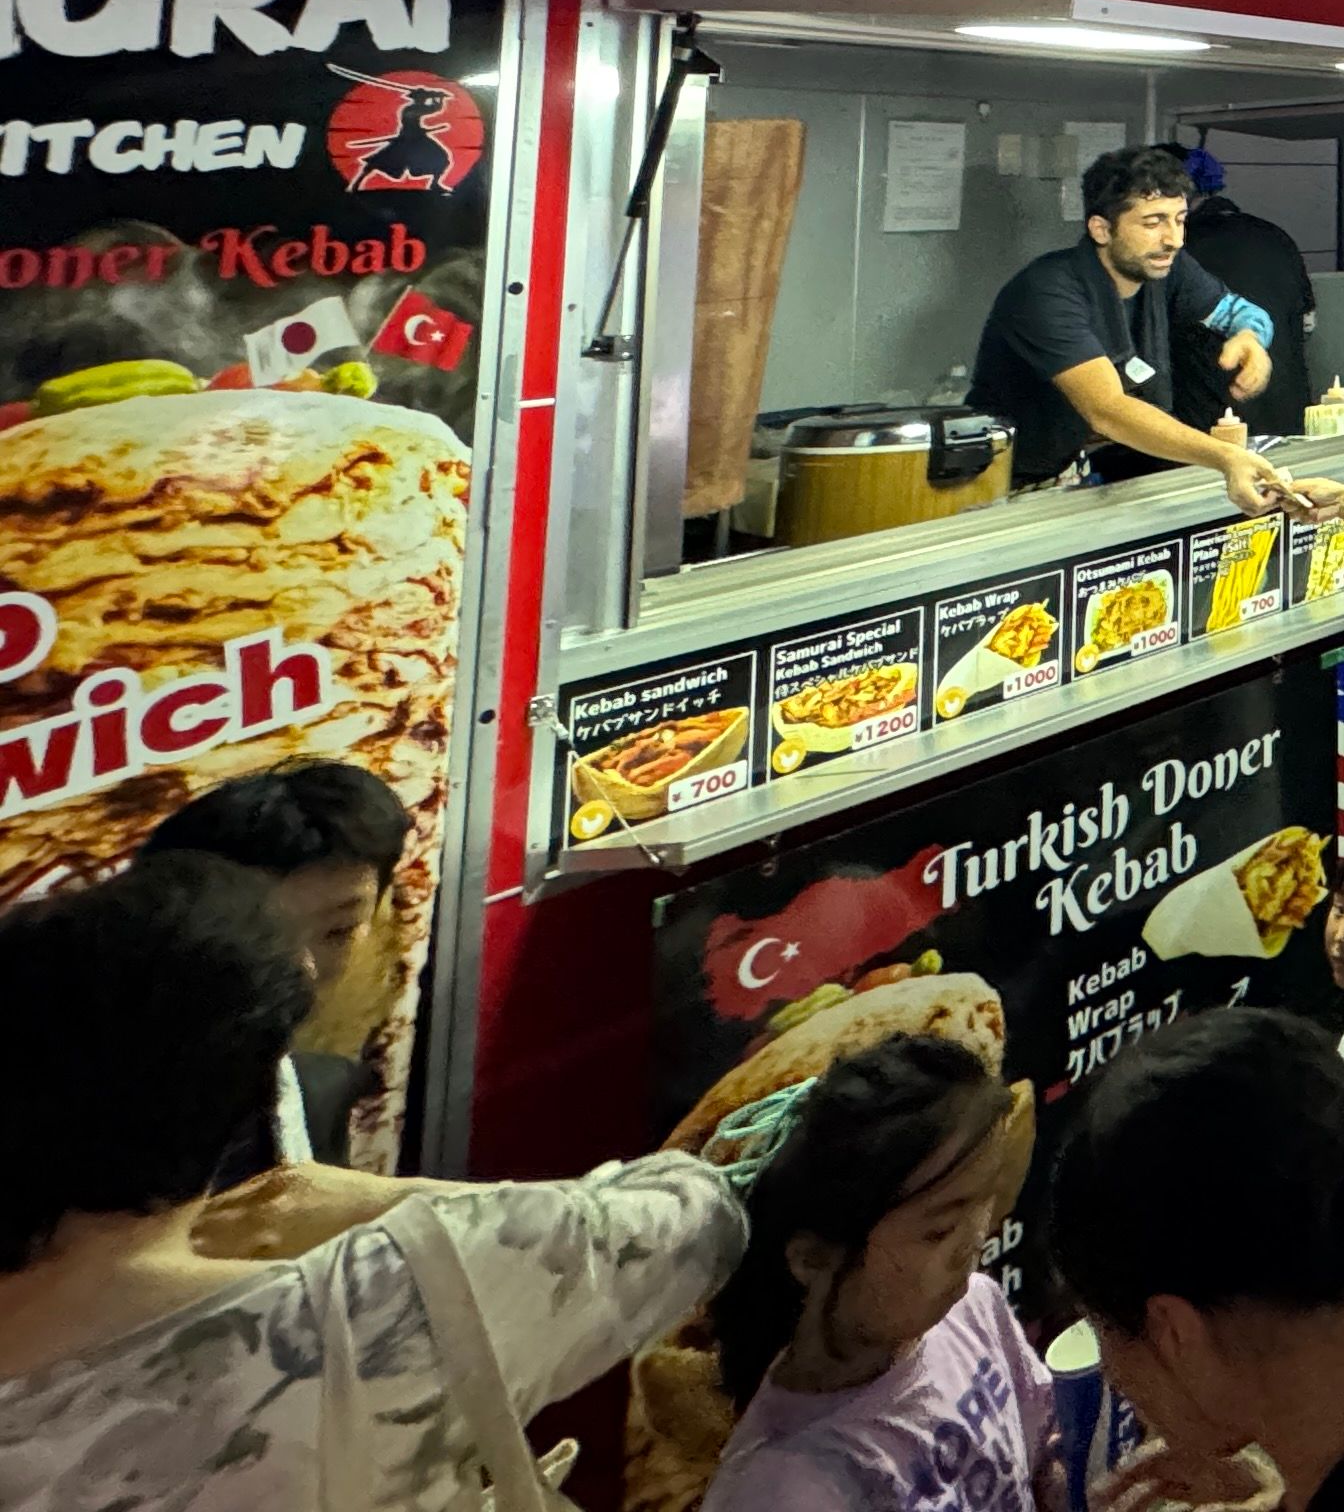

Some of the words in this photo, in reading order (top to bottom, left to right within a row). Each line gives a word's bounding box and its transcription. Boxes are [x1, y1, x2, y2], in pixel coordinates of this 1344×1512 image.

[0, 119, 305, 176] ITCHEN
[203, 224, 428, 287] Kebab
[939, 598, 983, 621] Kebab
[984, 589, 1020, 609] Wrap
[1251, 595, 1275, 612] 700
[775, 659, 820, 682] Kebab
[821, 641, 884, 669] Sandwich
[776, 635, 843, 666] Samurai
[845, 618, 902, 646] Special
[575, 691, 637, 721] Kebab
[640, 666, 730, 702] sandwich
[576, 688, 722, 741] ケバブサンドイッチ
[690, 770, 737, 799] 700
[923, 782, 1131, 909] Turkish
[1141, 729, 1282, 816] Doner
[1035, 822, 1198, 936] Kebab
[1068, 946, 1147, 1006] Kebab
[1068, 990, 1135, 1040] Wrap
